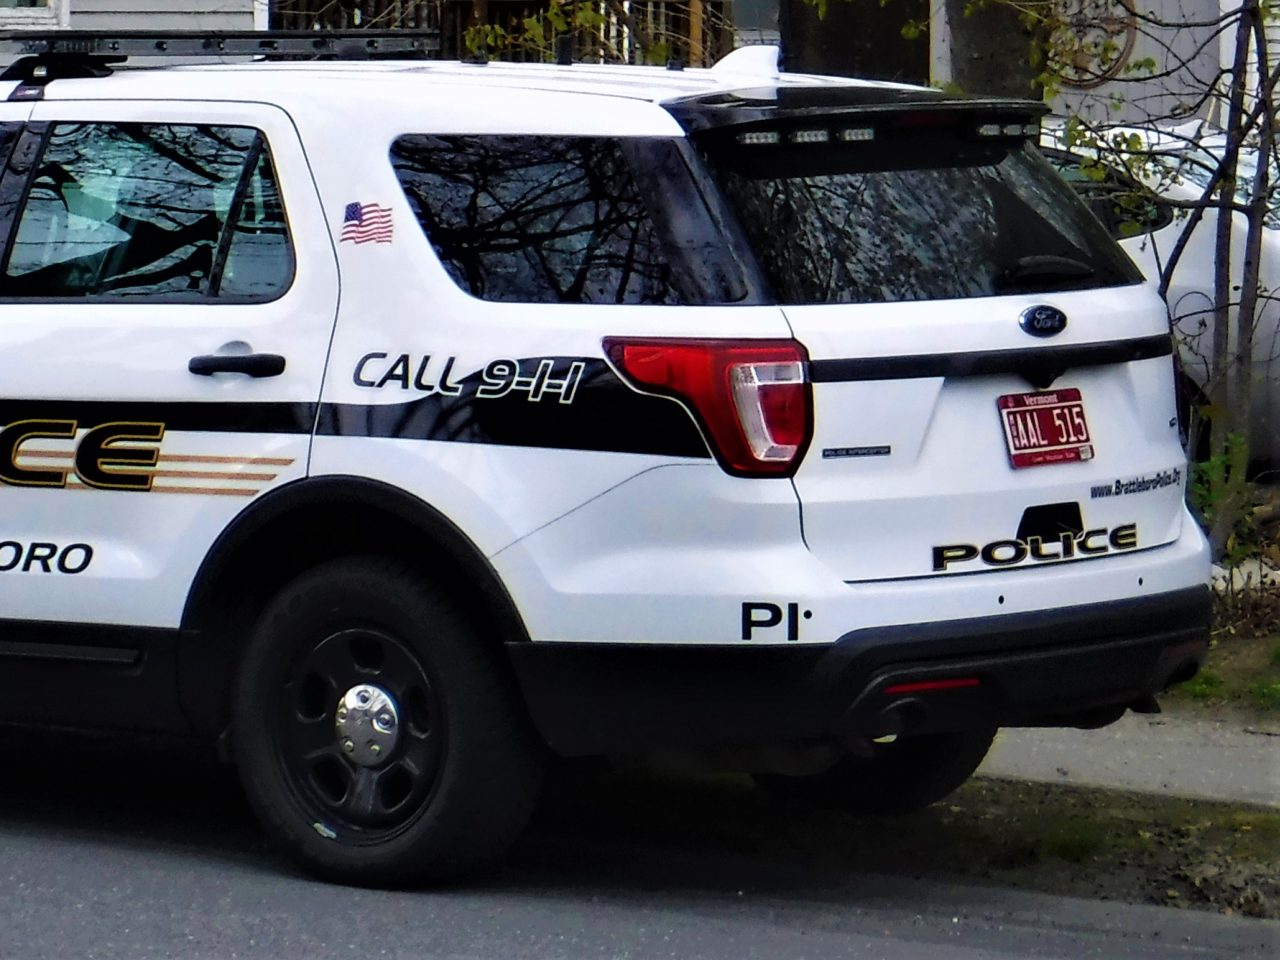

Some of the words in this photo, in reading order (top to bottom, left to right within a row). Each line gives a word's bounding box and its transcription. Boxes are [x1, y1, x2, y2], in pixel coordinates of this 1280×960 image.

[352, 352, 463, 396] CALL
[1023, 393, 1058, 406] Vermont
[1017, 411, 1048, 448] AAL
[1052, 406, 1087, 443] 515
[932, 522, 1137, 572] POLICE
